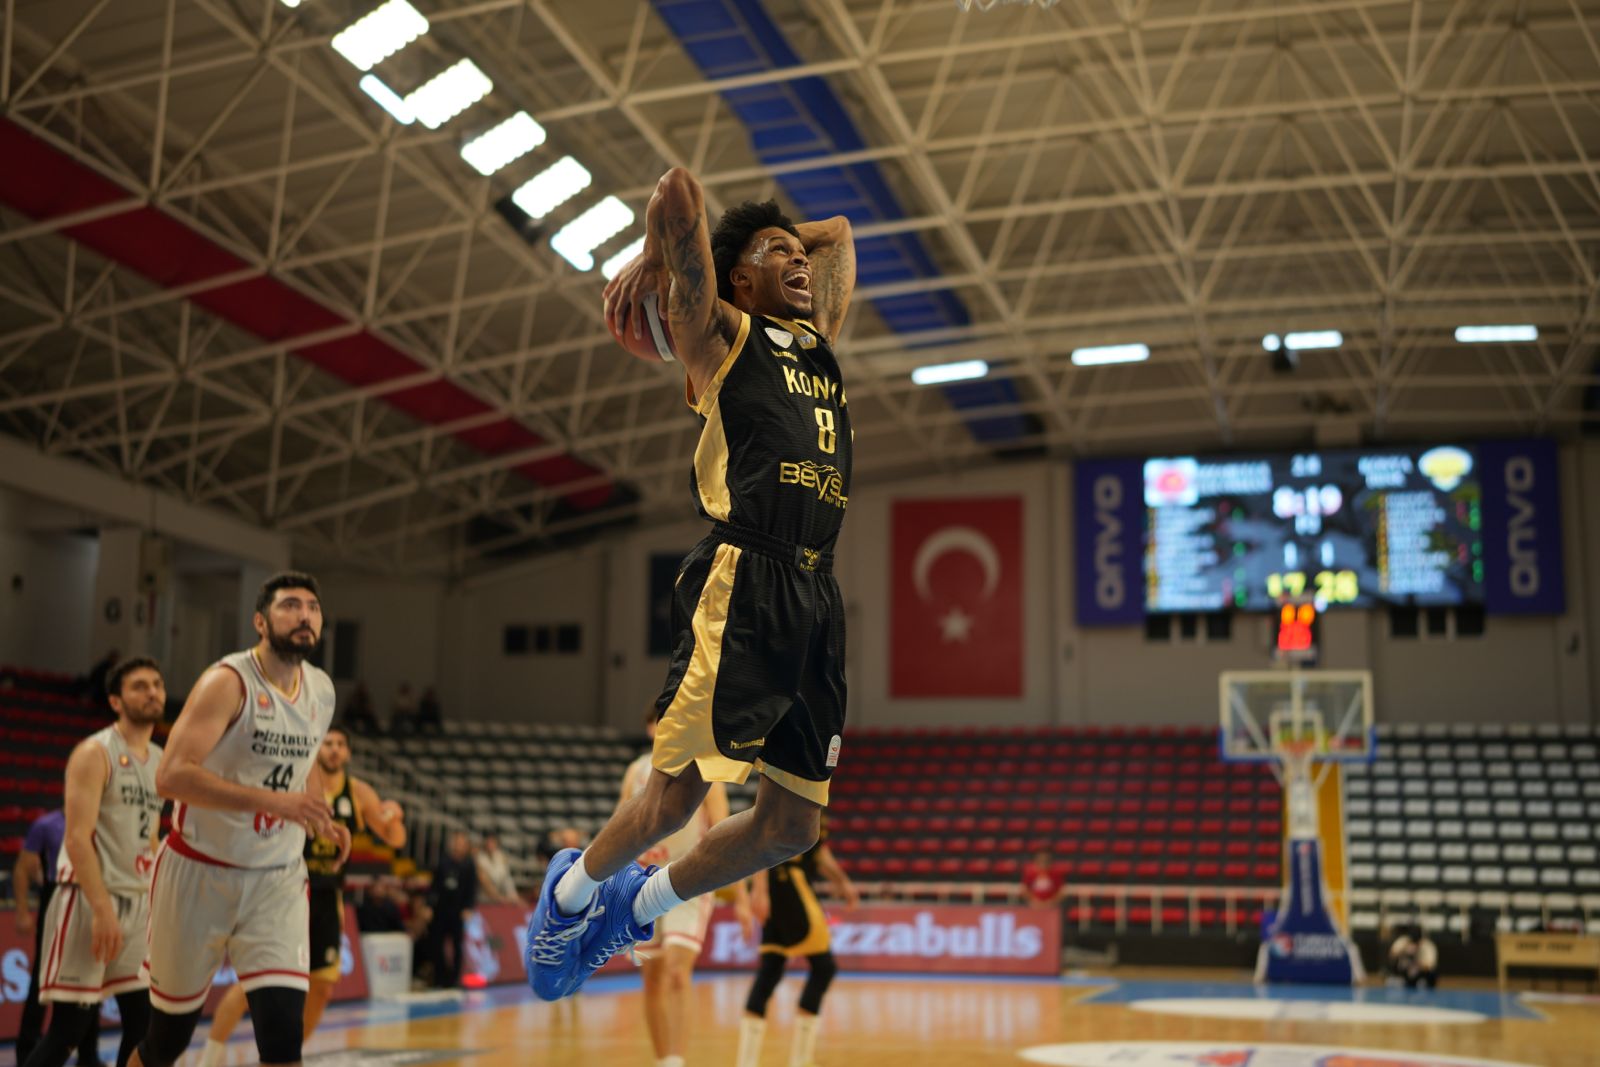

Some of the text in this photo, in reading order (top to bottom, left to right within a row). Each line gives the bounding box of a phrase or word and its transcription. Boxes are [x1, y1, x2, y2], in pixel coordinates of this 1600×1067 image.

[814, 407, 836, 454] 8
[262, 763, 294, 792] 44
[829, 912, 1043, 958] zzabulls
